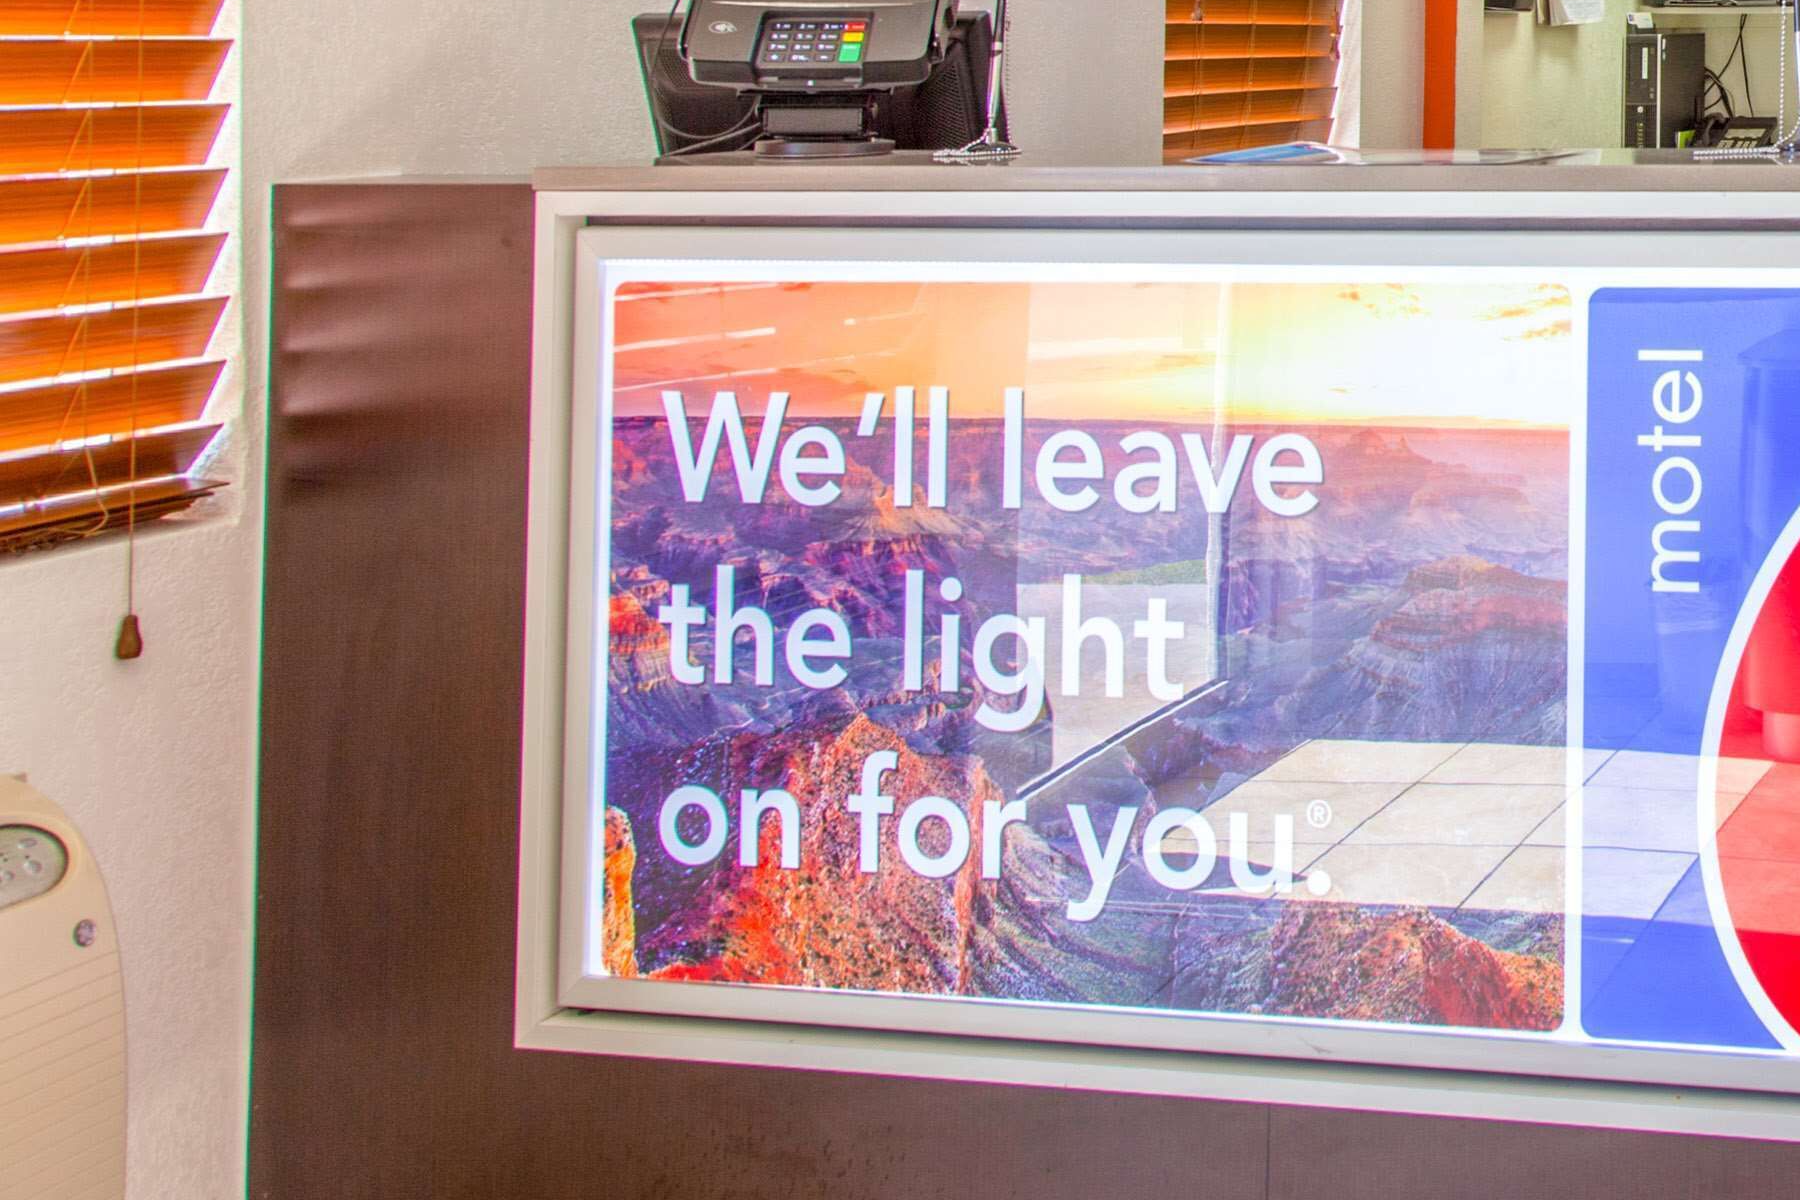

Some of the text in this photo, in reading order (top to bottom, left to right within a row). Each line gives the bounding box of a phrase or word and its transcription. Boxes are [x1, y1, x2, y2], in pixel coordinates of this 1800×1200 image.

[660, 385, 1323, 518] We’ll leave
[1637, 349, 1703, 594] motel
[658, 564, 1184, 732] the light
[657, 786, 800, 871] on
[847, 750, 1028, 882] for
